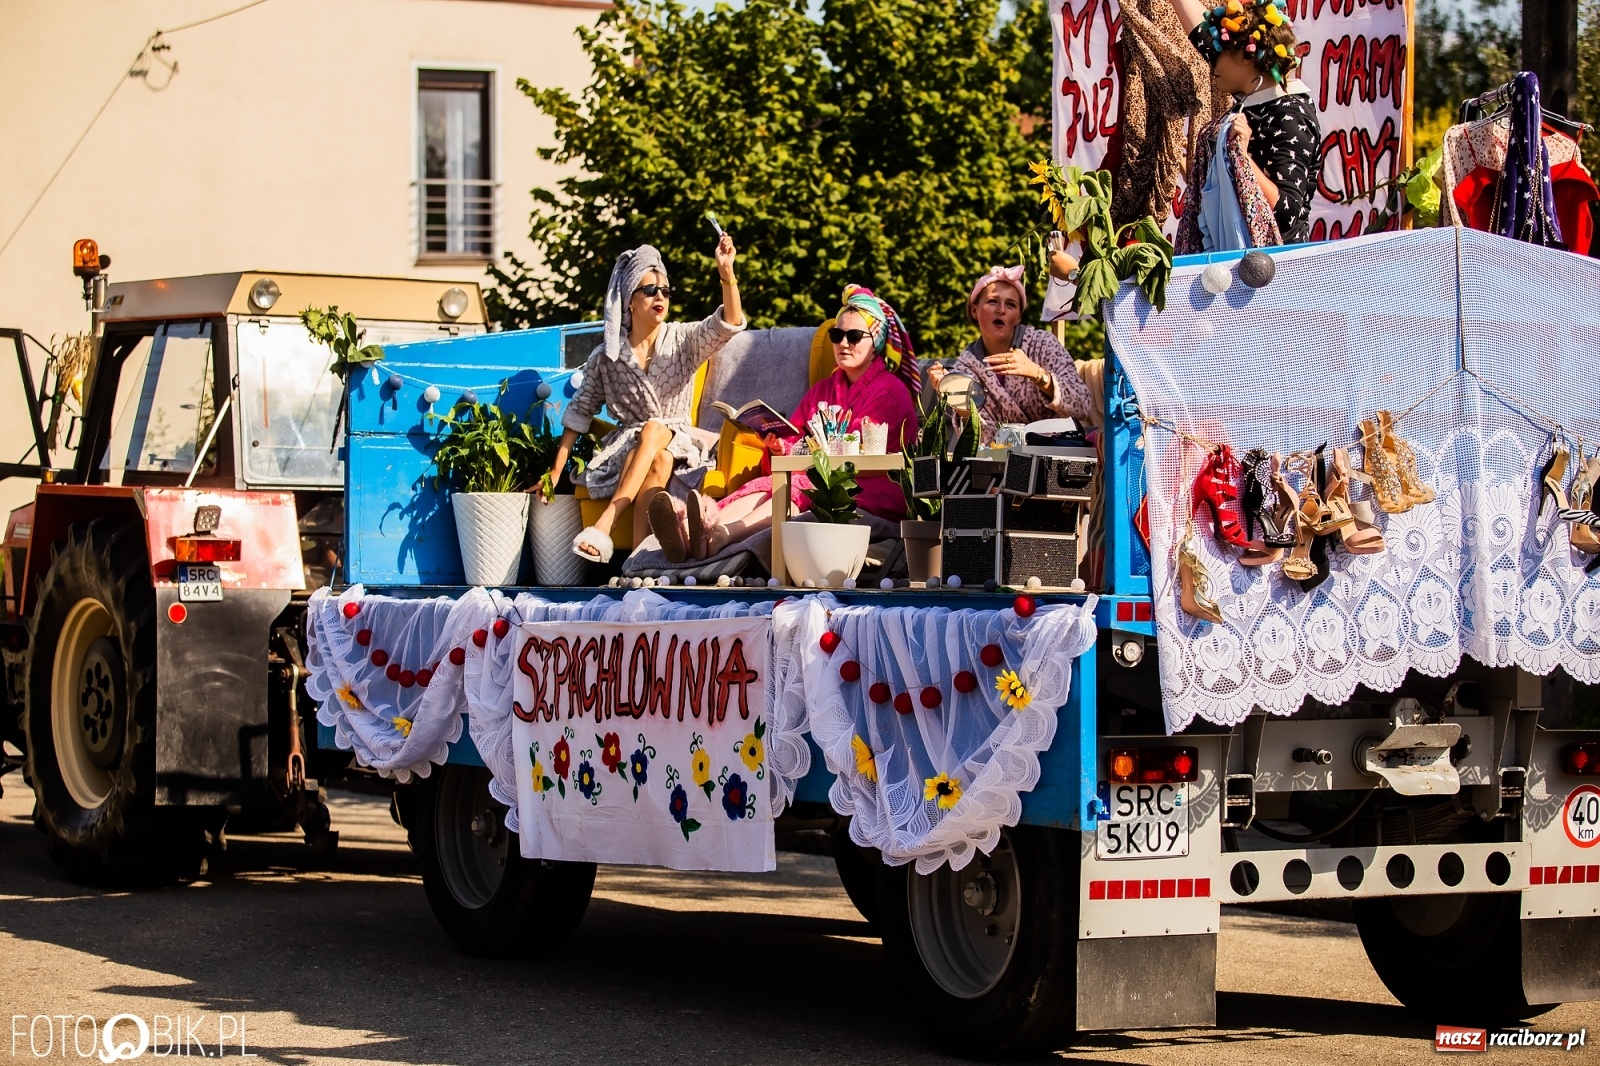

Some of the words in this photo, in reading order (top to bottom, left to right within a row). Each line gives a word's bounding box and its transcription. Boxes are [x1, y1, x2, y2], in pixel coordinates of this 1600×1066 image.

[190, 568, 215, 581] SRC
[183, 585, 219, 597] 84V4
[513, 630, 758, 726] SZPACHLOWNIA
[1116, 784, 1174, 816] SRC
[1572, 796, 1599, 825] 40
[1107, 821, 1180, 854] 5KU9
[1578, 826, 1594, 839] km
